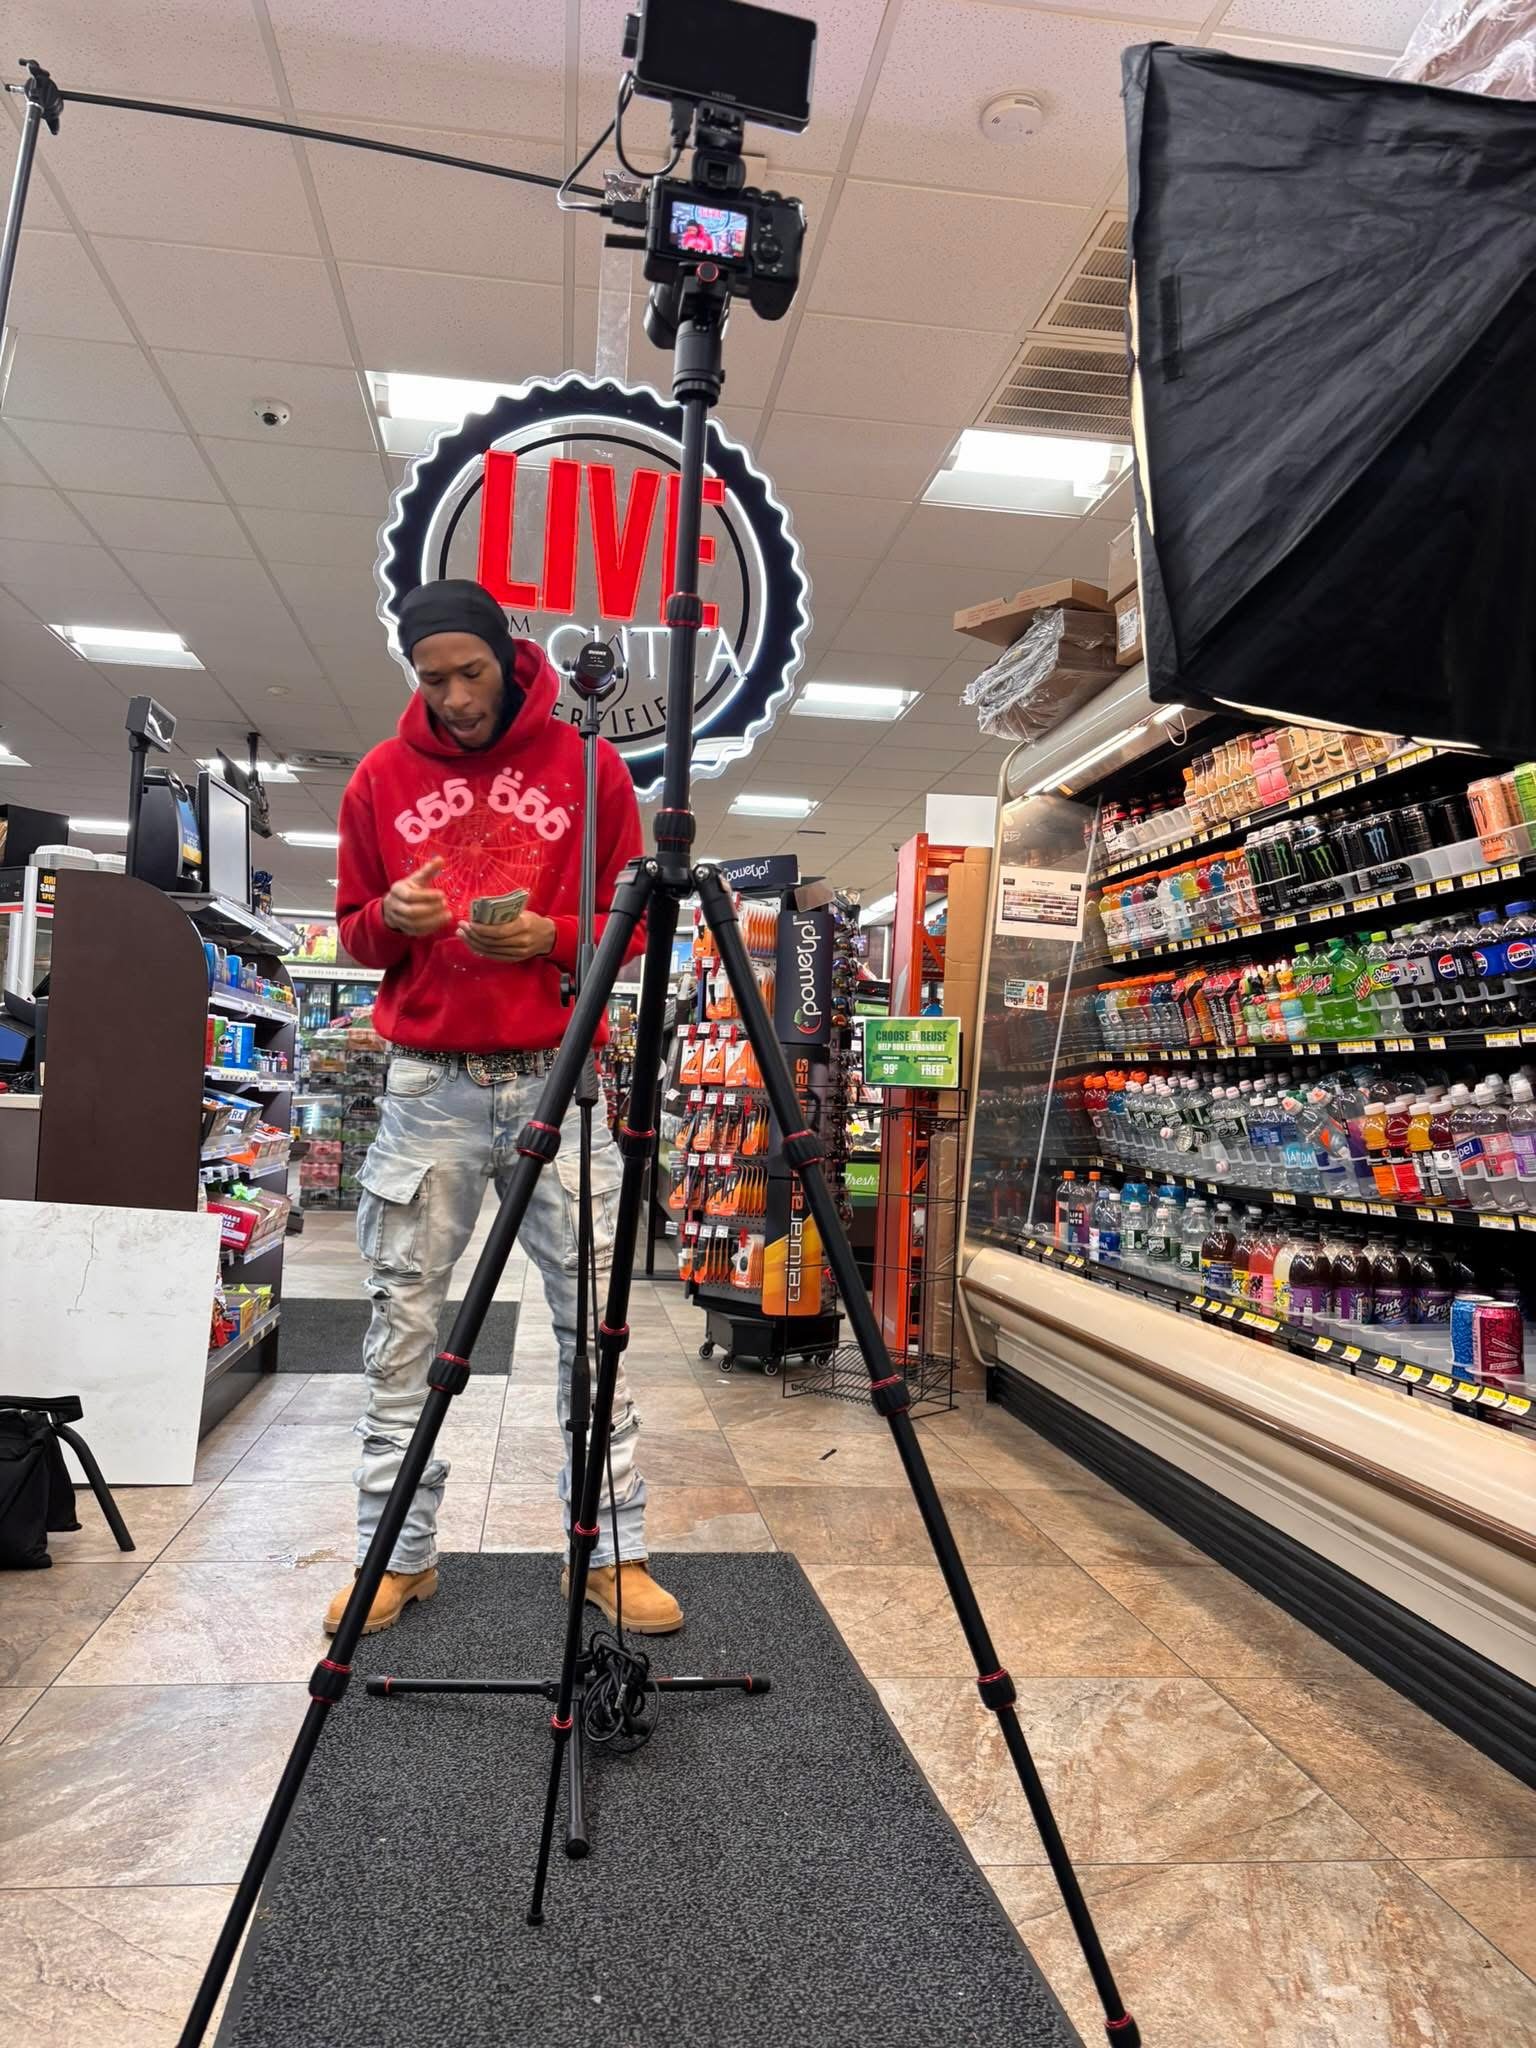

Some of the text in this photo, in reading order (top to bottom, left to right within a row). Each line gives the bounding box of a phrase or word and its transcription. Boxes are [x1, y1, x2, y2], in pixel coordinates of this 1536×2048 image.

[477, 449, 726, 630] LIVE
[551, 696, 668, 735] ERIFIE
[875, 1030, 910, 1042] CHOOSE
[920, 1030, 948, 1042] REUSE
[878, 1043, 945, 1052] HELP OUR ENVIRONMENT
[921, 1064, 944, 1076] FREE!
[1457, 1141, 1474, 1160] pel
[1069, 1211, 1083, 1219] LIFE
[1374, 1299, 1401, 1315] Brisk
